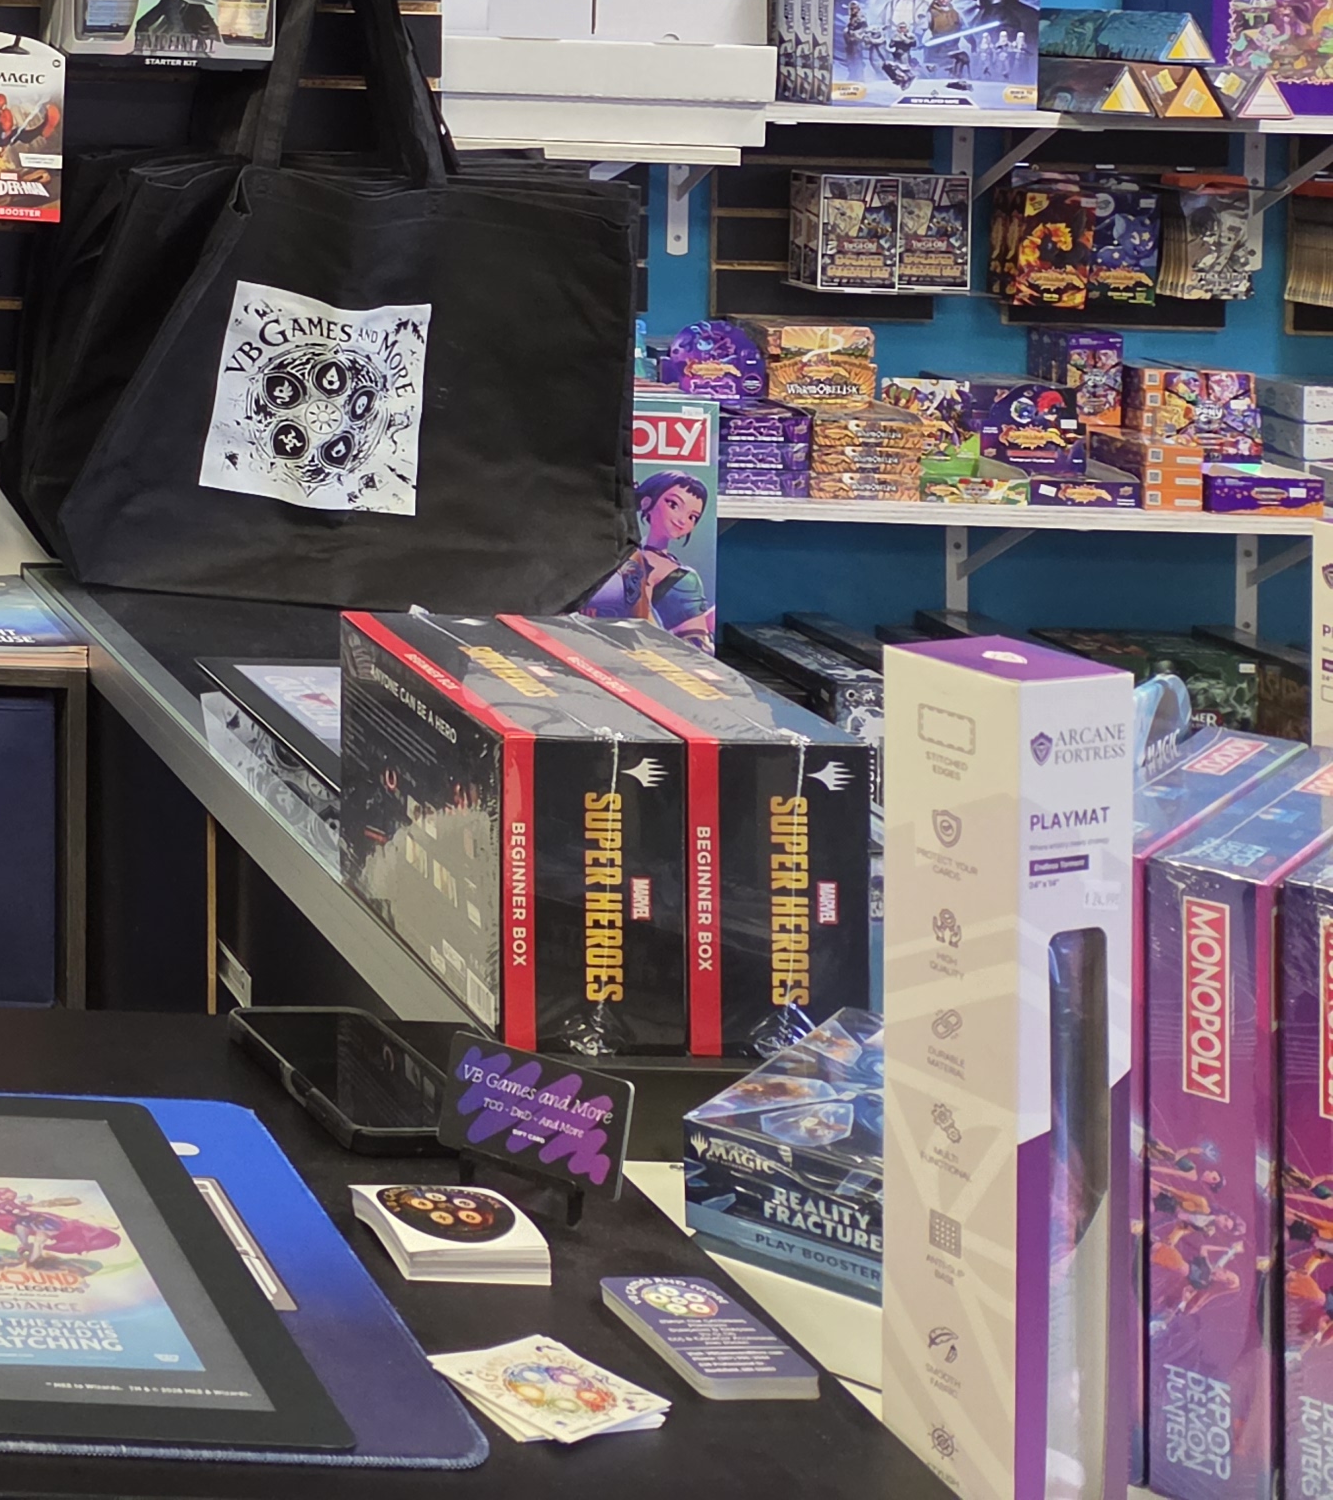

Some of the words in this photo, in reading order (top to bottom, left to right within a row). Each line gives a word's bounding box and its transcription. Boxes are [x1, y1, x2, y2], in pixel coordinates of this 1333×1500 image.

[181, 59, 197, 67] KIT
[223, 340, 264, 377] VB
[258, 318, 353, 351] GAMES
[357, 327, 379, 344] AND
[376, 337, 417, 399] MORE
[1054, 744, 1126, 765] FORTRESS
[1055, 723, 1126, 747] ARCANE
[584, 792, 622, 892] SUPER
[1030, 806, 1110, 831] PLAYMAT
[511, 821, 527, 922] BEGINNER
[511, 926, 527, 967] BOX
[584, 896, 624, 1003] HEROES
[1190, 905, 1223, 1095] MONOPOLY
[463, 1064, 484, 1083] VB
[486, 1072, 537, 1100] Games
[538, 1091, 569, 1112] and
[571, 1099, 613, 1125] More
[1163, 1363, 1189, 1465] HUNTERS
[1186, 1369, 1212, 1475] DEMON
[1206, 1376, 1231, 1482] KPOP
